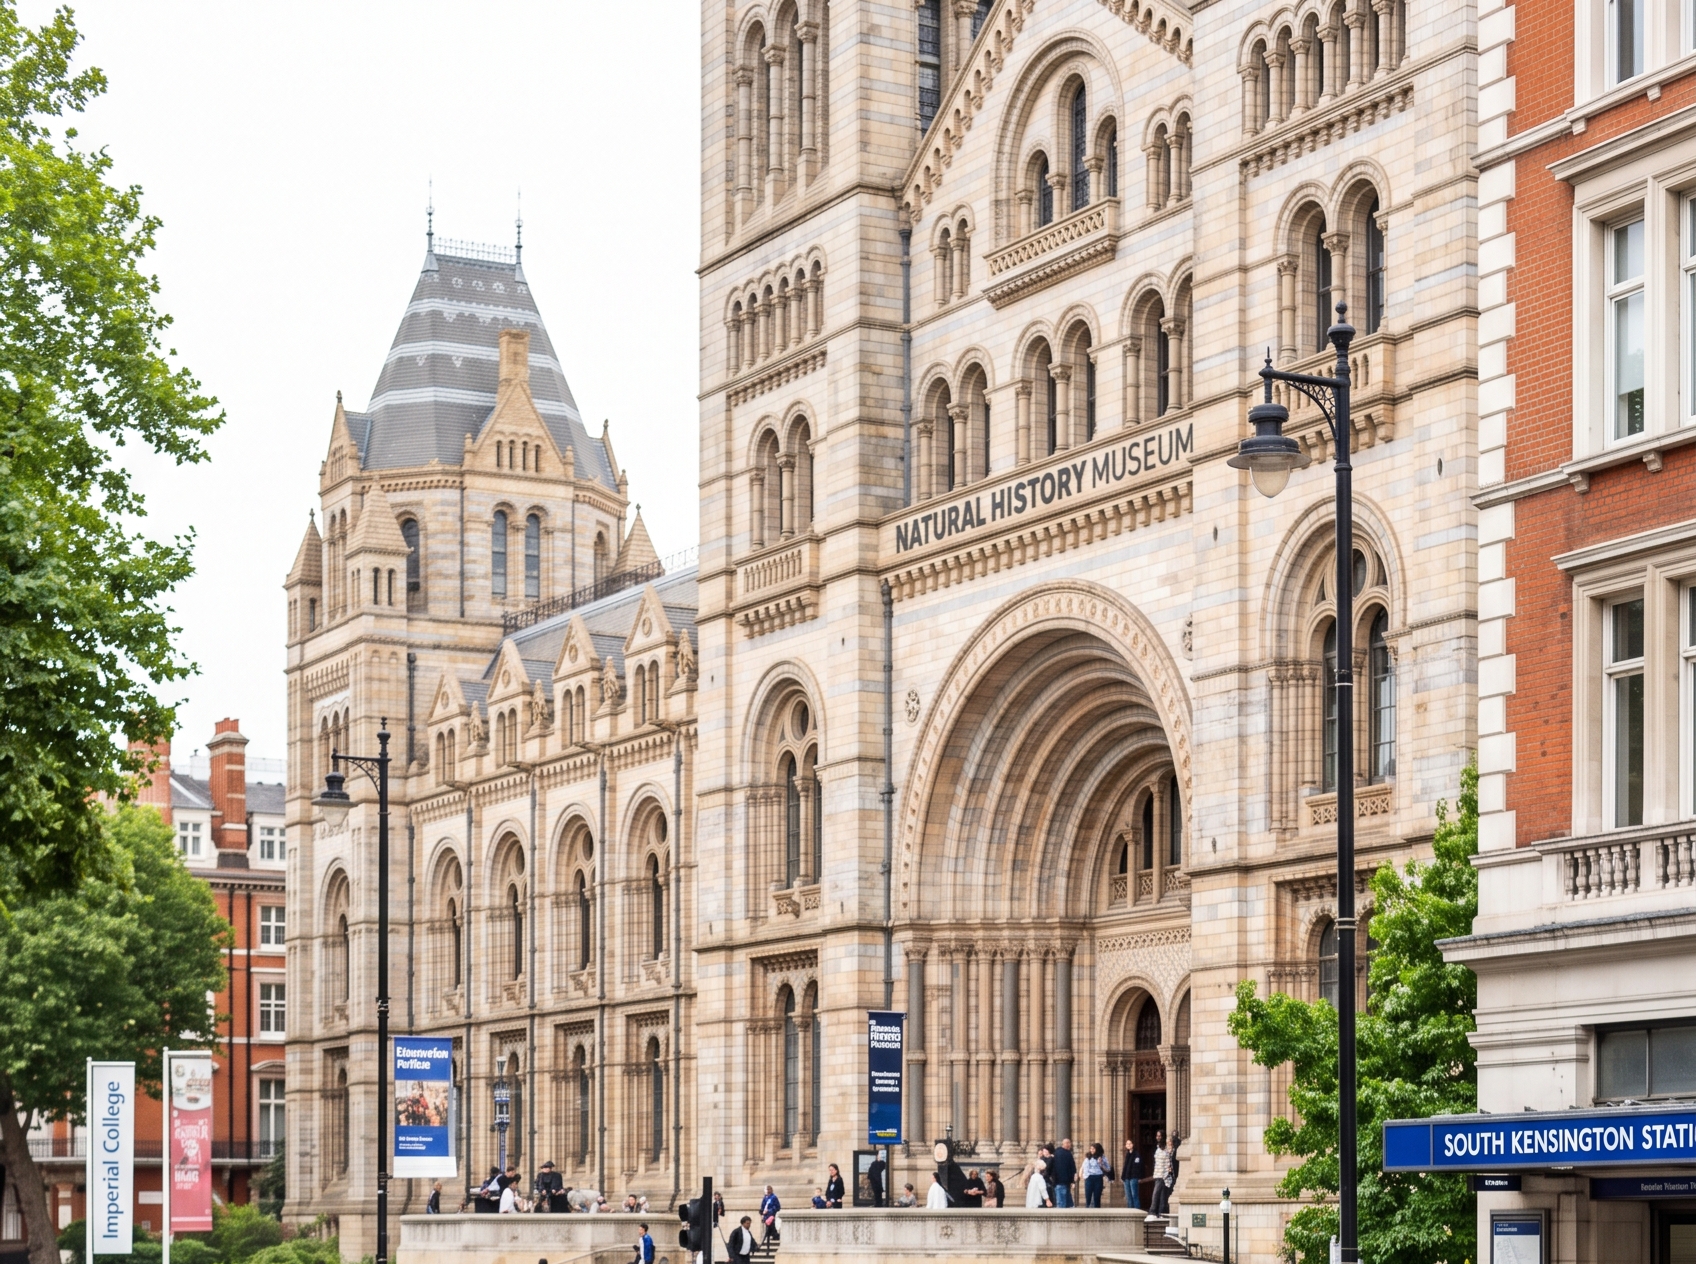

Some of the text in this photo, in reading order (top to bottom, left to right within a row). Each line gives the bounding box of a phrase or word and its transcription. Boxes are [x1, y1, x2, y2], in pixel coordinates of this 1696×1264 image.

[896, 423, 1193, 554] NATURAL HISTORY MUSEUM
[102, 1081, 125, 1239] Imperial College
[1444, 1123, 1696, 1157] SOUTH KENSINGTON STATI
